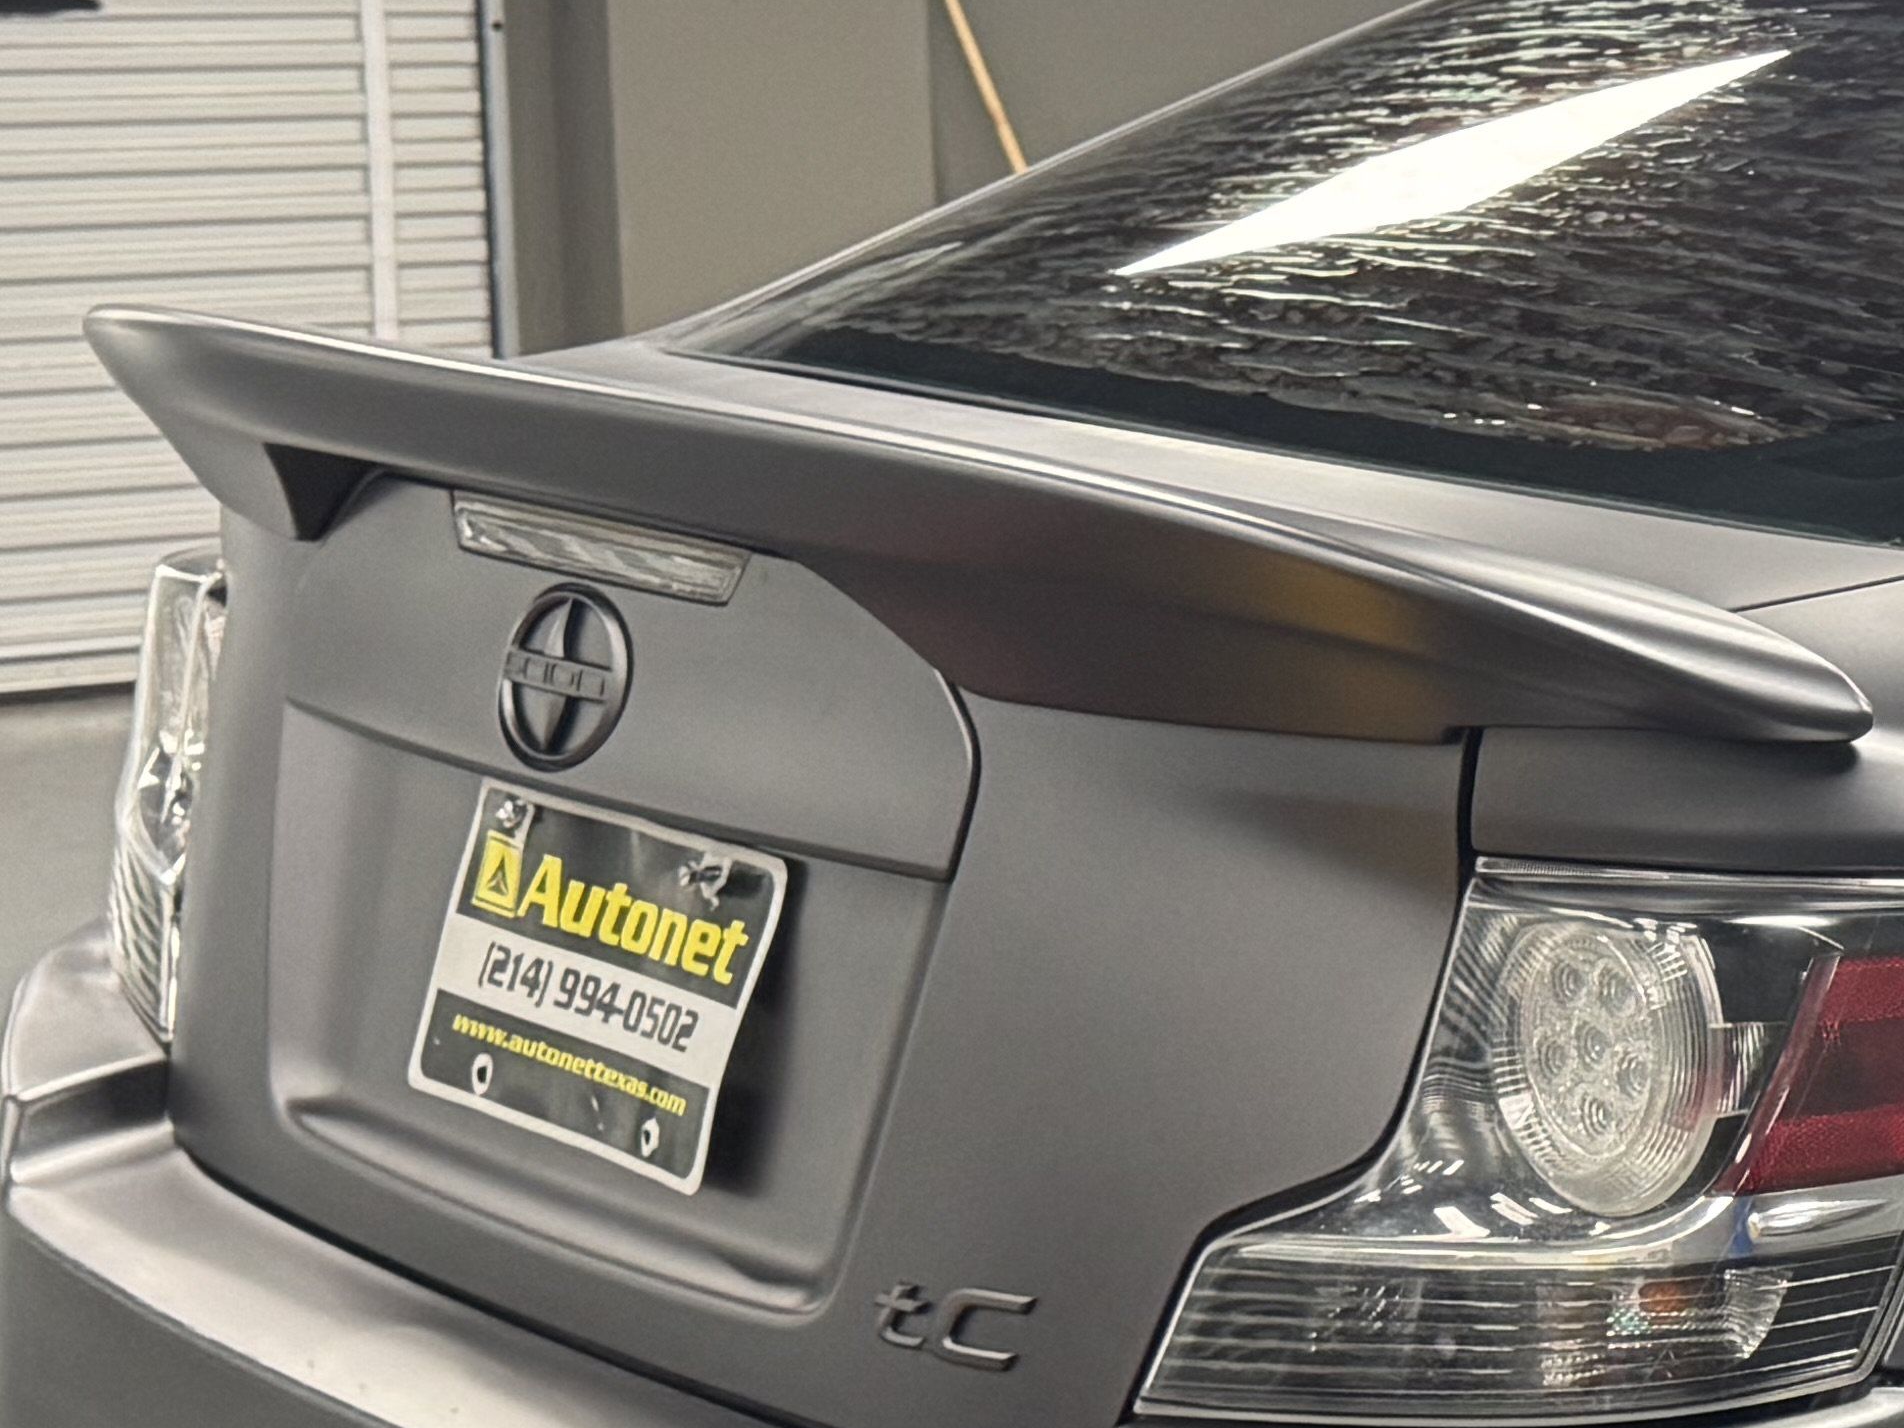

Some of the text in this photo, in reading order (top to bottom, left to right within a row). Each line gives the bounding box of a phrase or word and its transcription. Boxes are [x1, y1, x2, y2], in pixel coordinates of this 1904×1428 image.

[516, 854, 749, 985] Autonet
[477, 941, 699, 1052] (214) 994-0502
[452, 1014, 687, 1117] www.autonettexas.com
